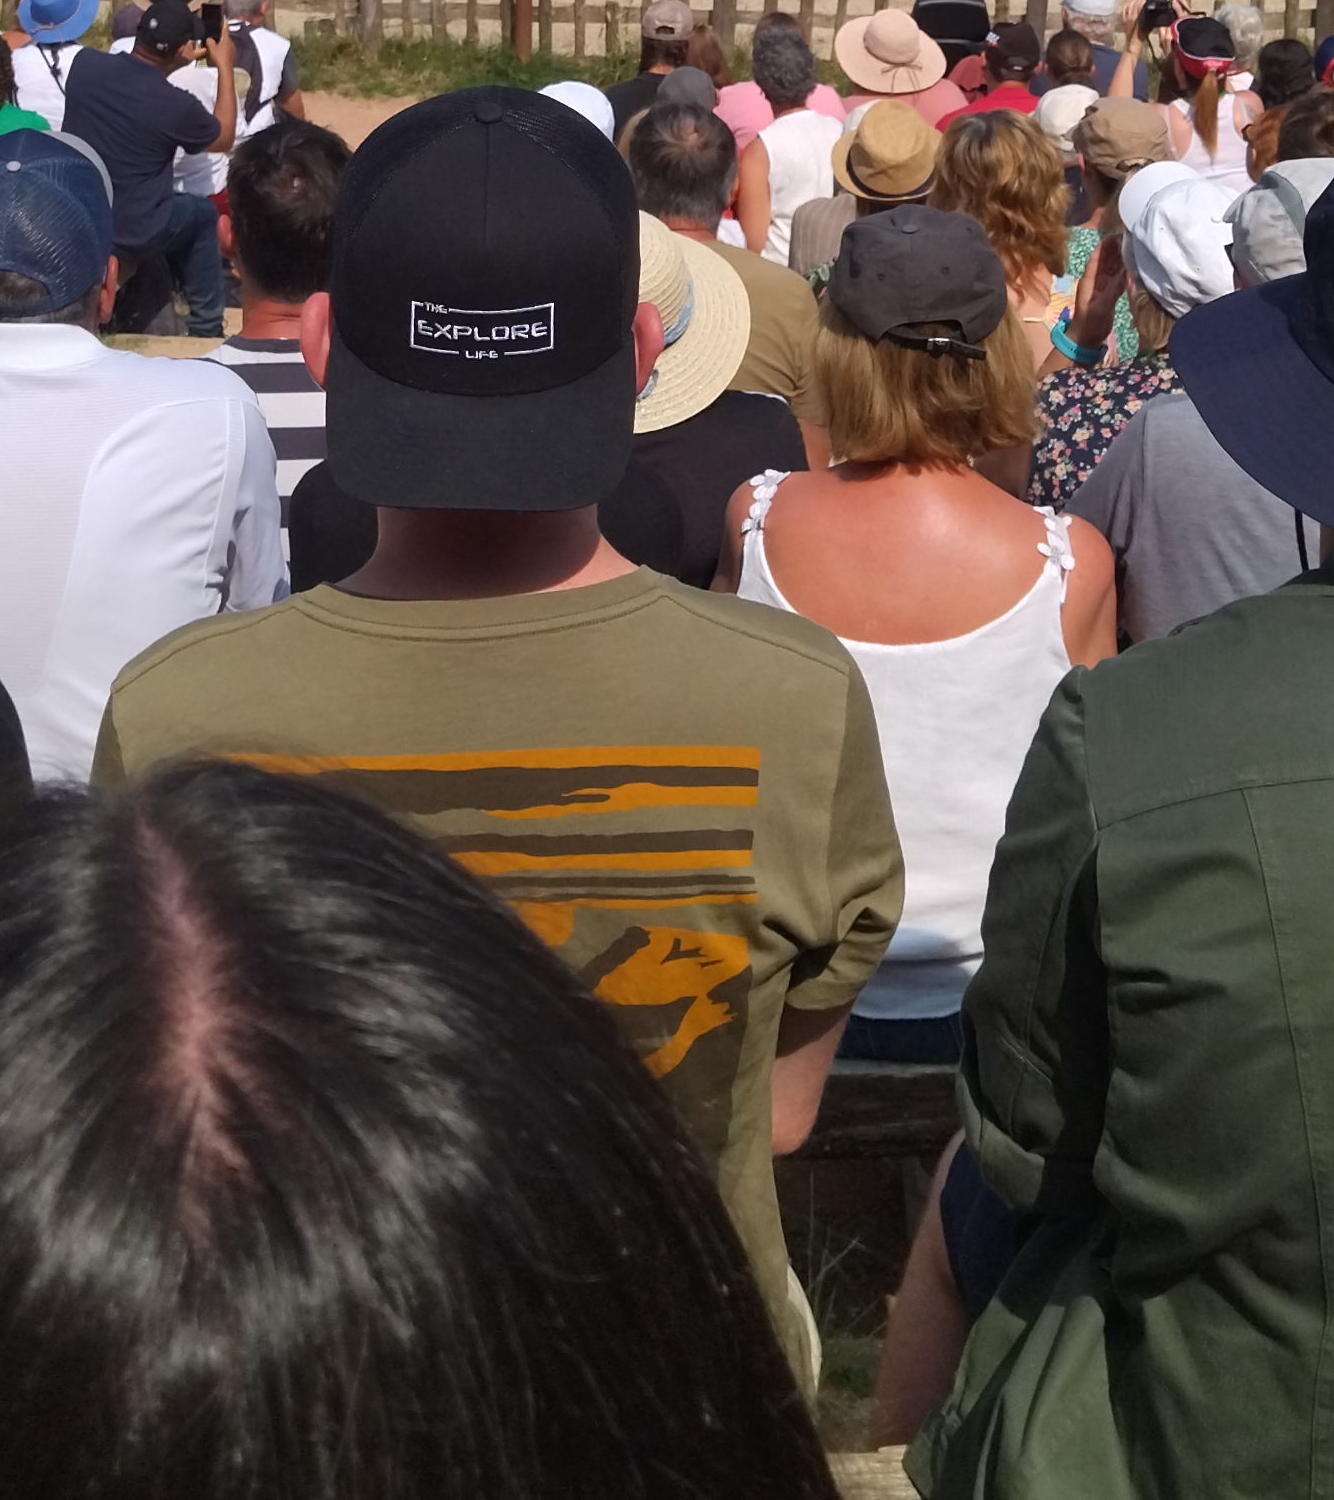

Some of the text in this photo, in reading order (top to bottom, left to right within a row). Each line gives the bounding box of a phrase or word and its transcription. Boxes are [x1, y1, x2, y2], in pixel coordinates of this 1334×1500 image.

[424, 302, 448, 314] THE
[417, 320, 548, 341] EXPLORE
[465, 350, 499, 359] LIFE
